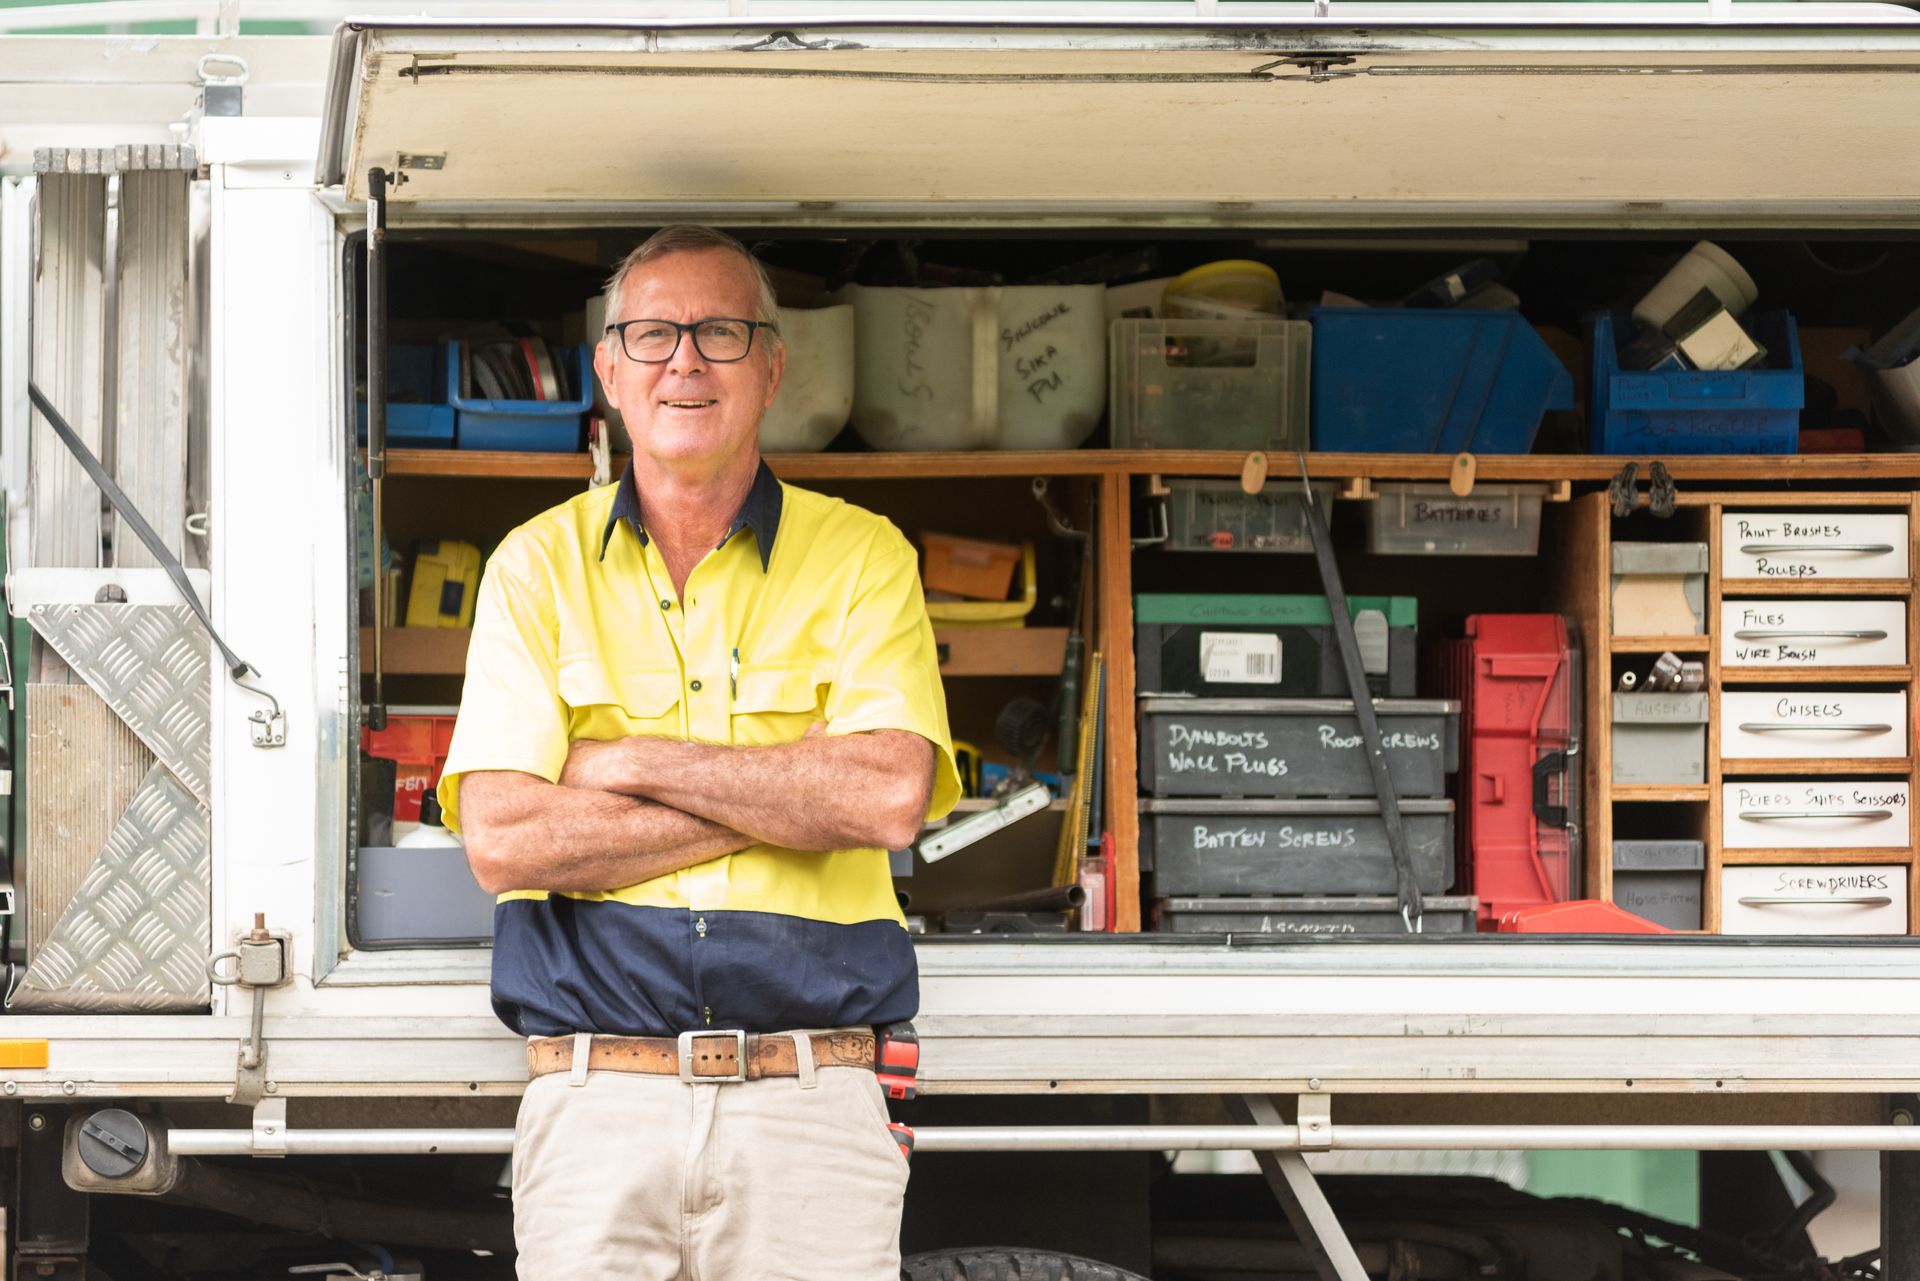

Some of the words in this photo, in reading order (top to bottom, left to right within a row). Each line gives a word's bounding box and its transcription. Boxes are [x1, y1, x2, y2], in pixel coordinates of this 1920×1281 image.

[1015, 345, 1059, 380] SIKA
[1738, 521, 1776, 539] PAINT
[1783, 522, 1842, 538] BRUSHES
[1756, 558, 1818, 577] ROLLERS
[1742, 610, 1785, 628] FILES
[1735, 649, 1771, 661] WIRE
[1776, 698, 1843, 719] CHISELS
[1380, 730, 1440, 750] CREWS
[1168, 753, 1218, 773] WALL
[1225, 753, 1288, 776] PLUGS
[1279, 826, 1356, 849] SCREWS
[1774, 872, 1888, 891] SCREWDRIVERS
